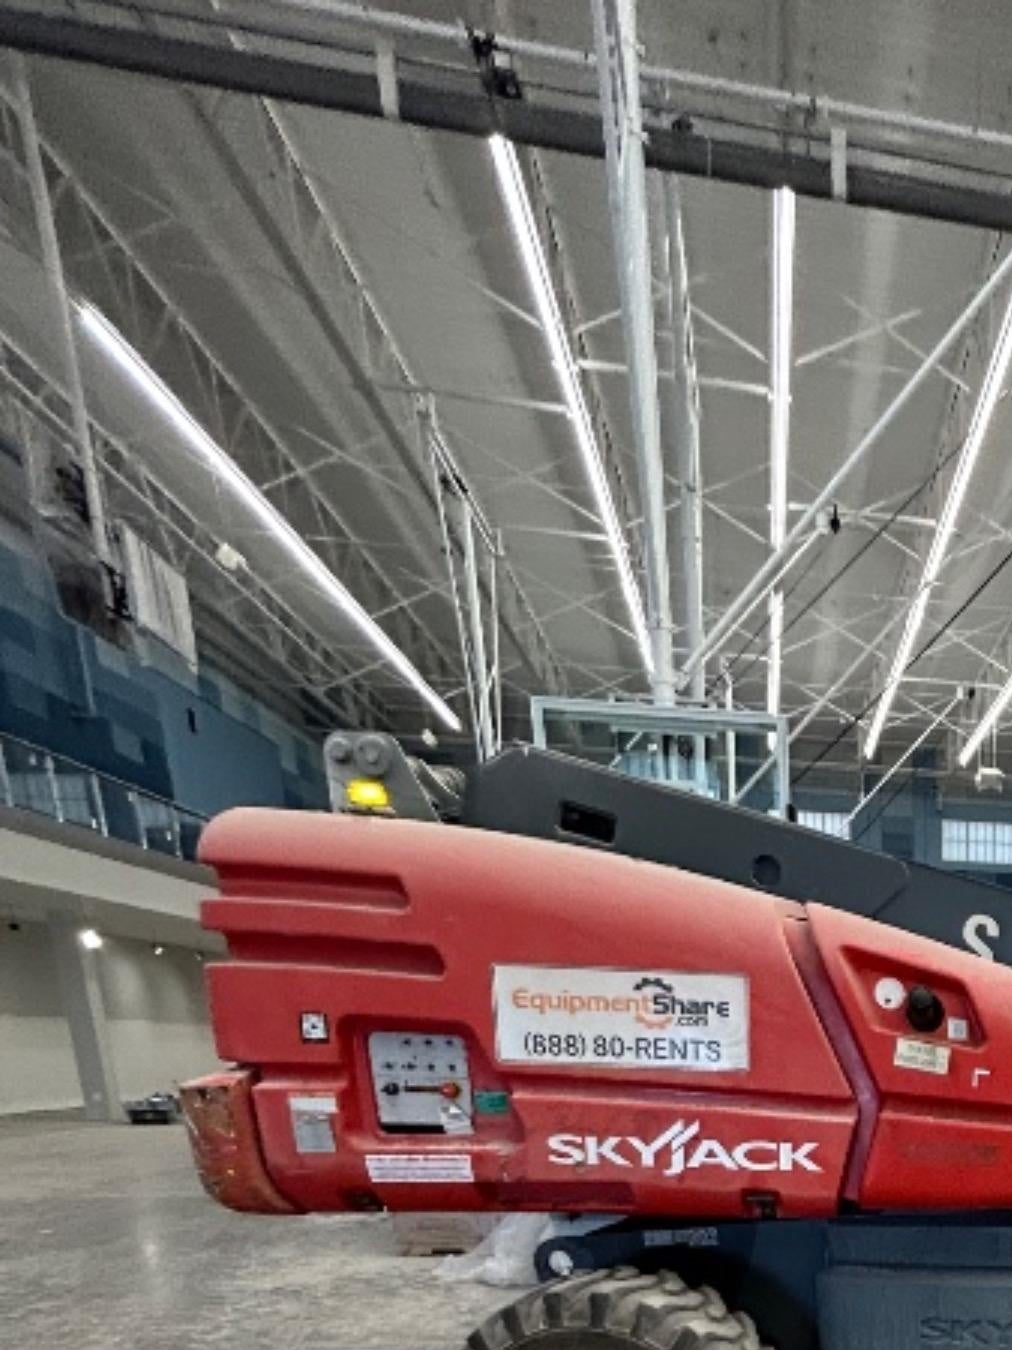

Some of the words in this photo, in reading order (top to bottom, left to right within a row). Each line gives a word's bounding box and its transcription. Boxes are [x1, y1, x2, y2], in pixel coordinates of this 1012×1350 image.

[511, 987, 730, 1018] EquipmentShare
[592, 1033, 722, 1063] 80-RENTS
[546, 1117, 825, 1177] SKYJACK
